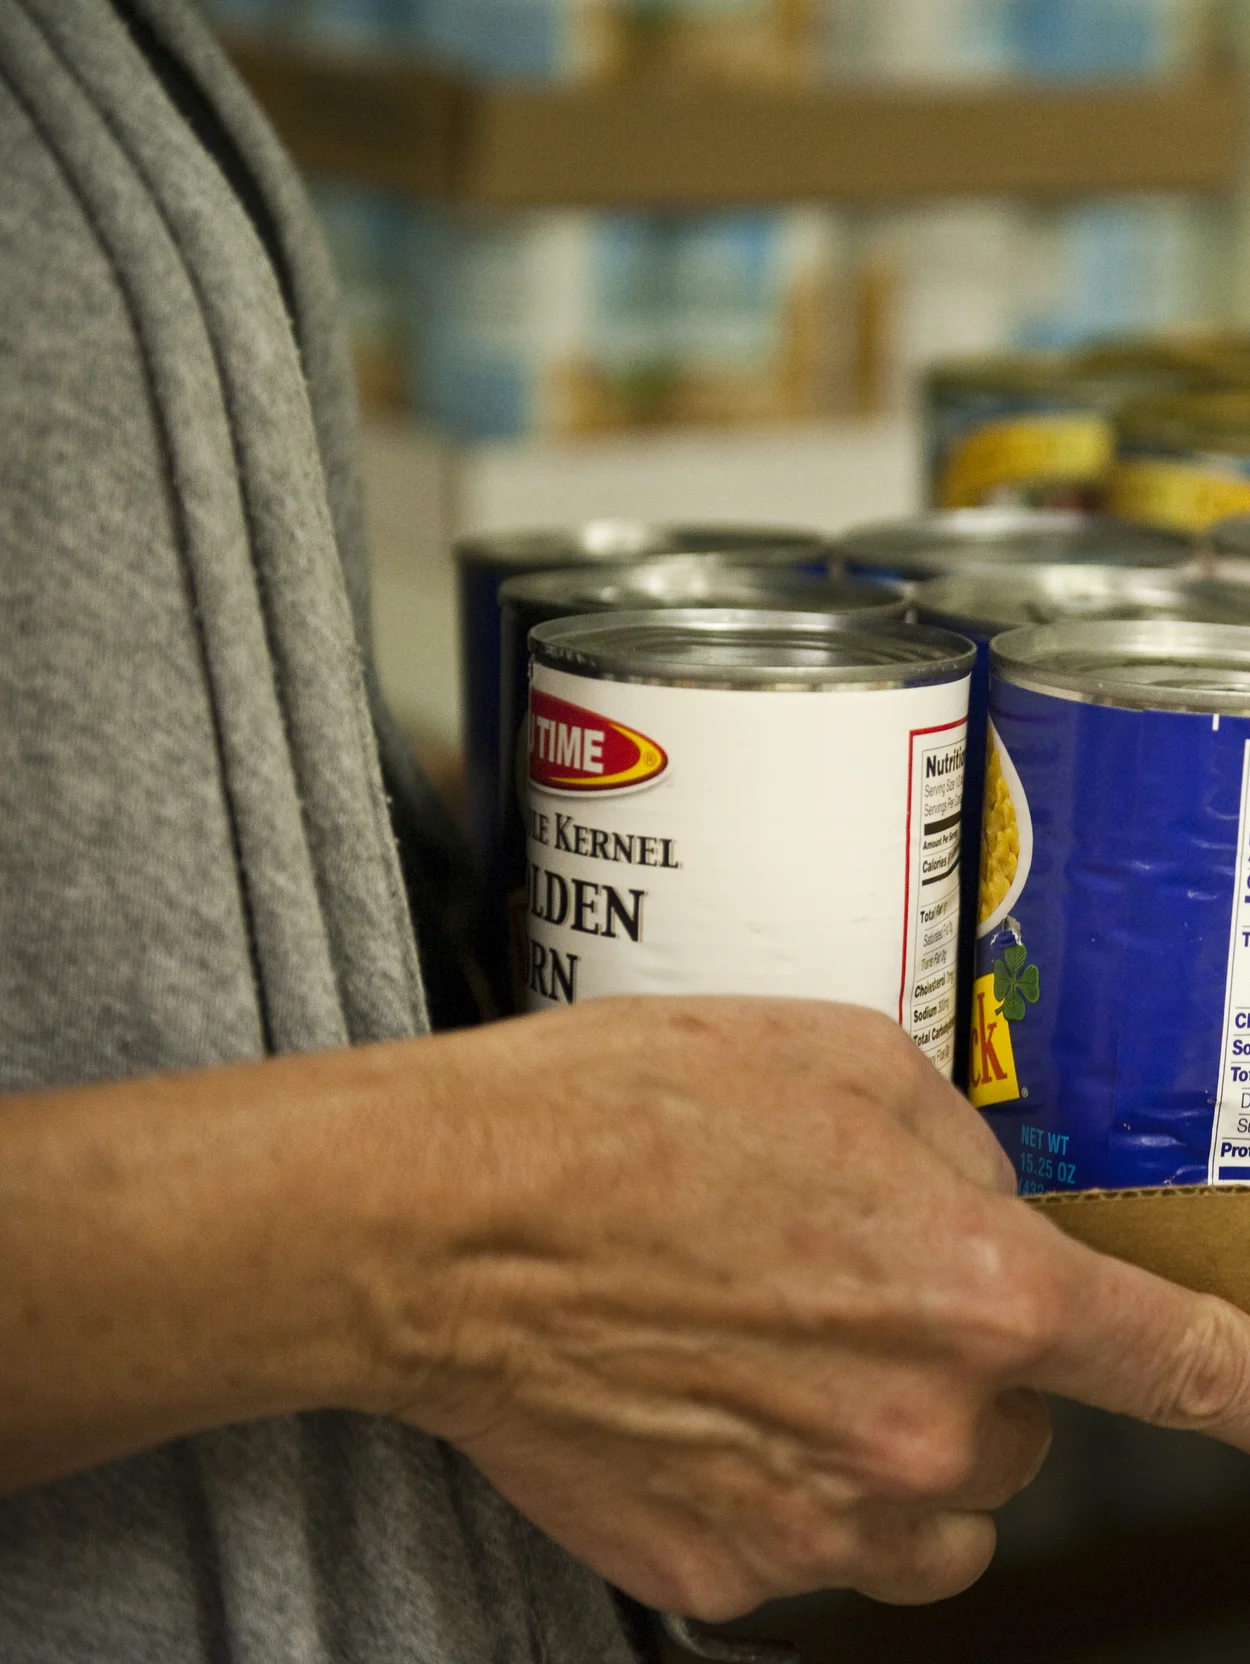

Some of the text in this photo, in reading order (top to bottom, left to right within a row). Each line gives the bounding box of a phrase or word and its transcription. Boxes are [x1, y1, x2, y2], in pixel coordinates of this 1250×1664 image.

[554, 812, 683, 870] KERNEL
[922, 856, 947, 873] Calories
[529, 864, 648, 943] LDEN
[920, 906, 935, 924] Total
[914, 973, 945, 998] Cholesterol
[913, 1005, 937, 1023] Sodium
[1021, 1124, 1070, 1156] NET WT
[1020, 1151, 1077, 1185] 15.25 OZ
